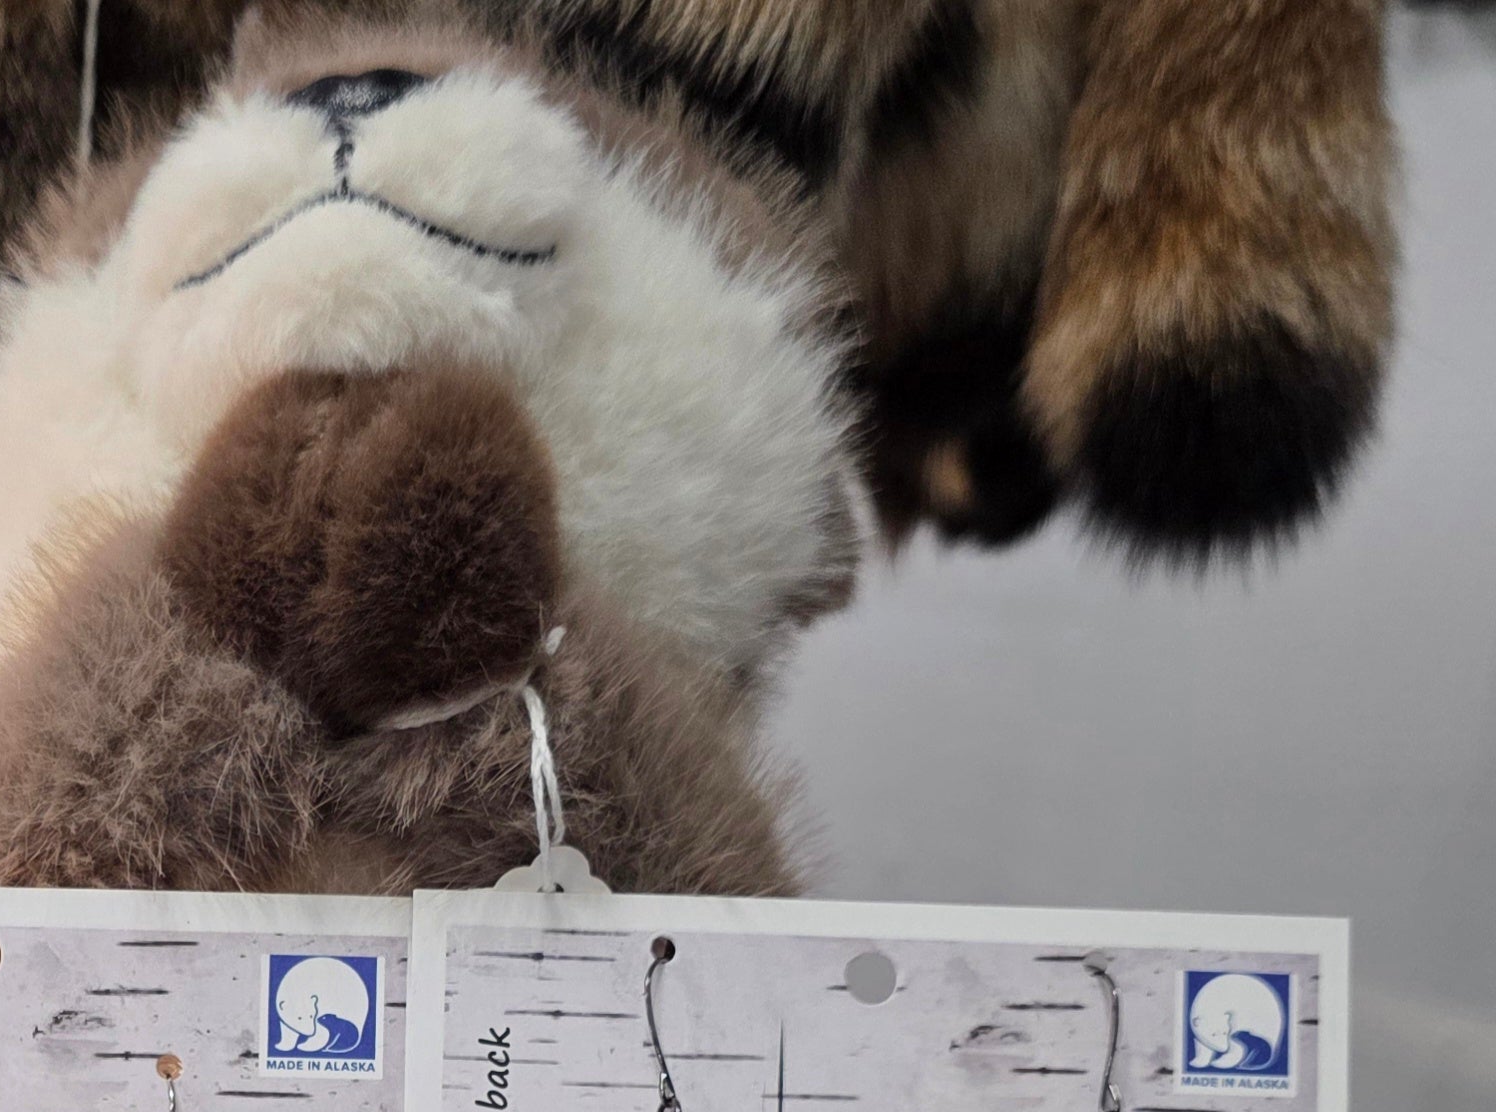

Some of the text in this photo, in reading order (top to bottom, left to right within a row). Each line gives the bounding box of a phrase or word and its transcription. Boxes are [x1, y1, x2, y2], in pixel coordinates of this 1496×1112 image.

[266, 1060, 375, 1072] MADE IN ALASKA
[475, 1026, 511, 1110] back
[1181, 1077, 1288, 1089] MADE IN ALASKA
